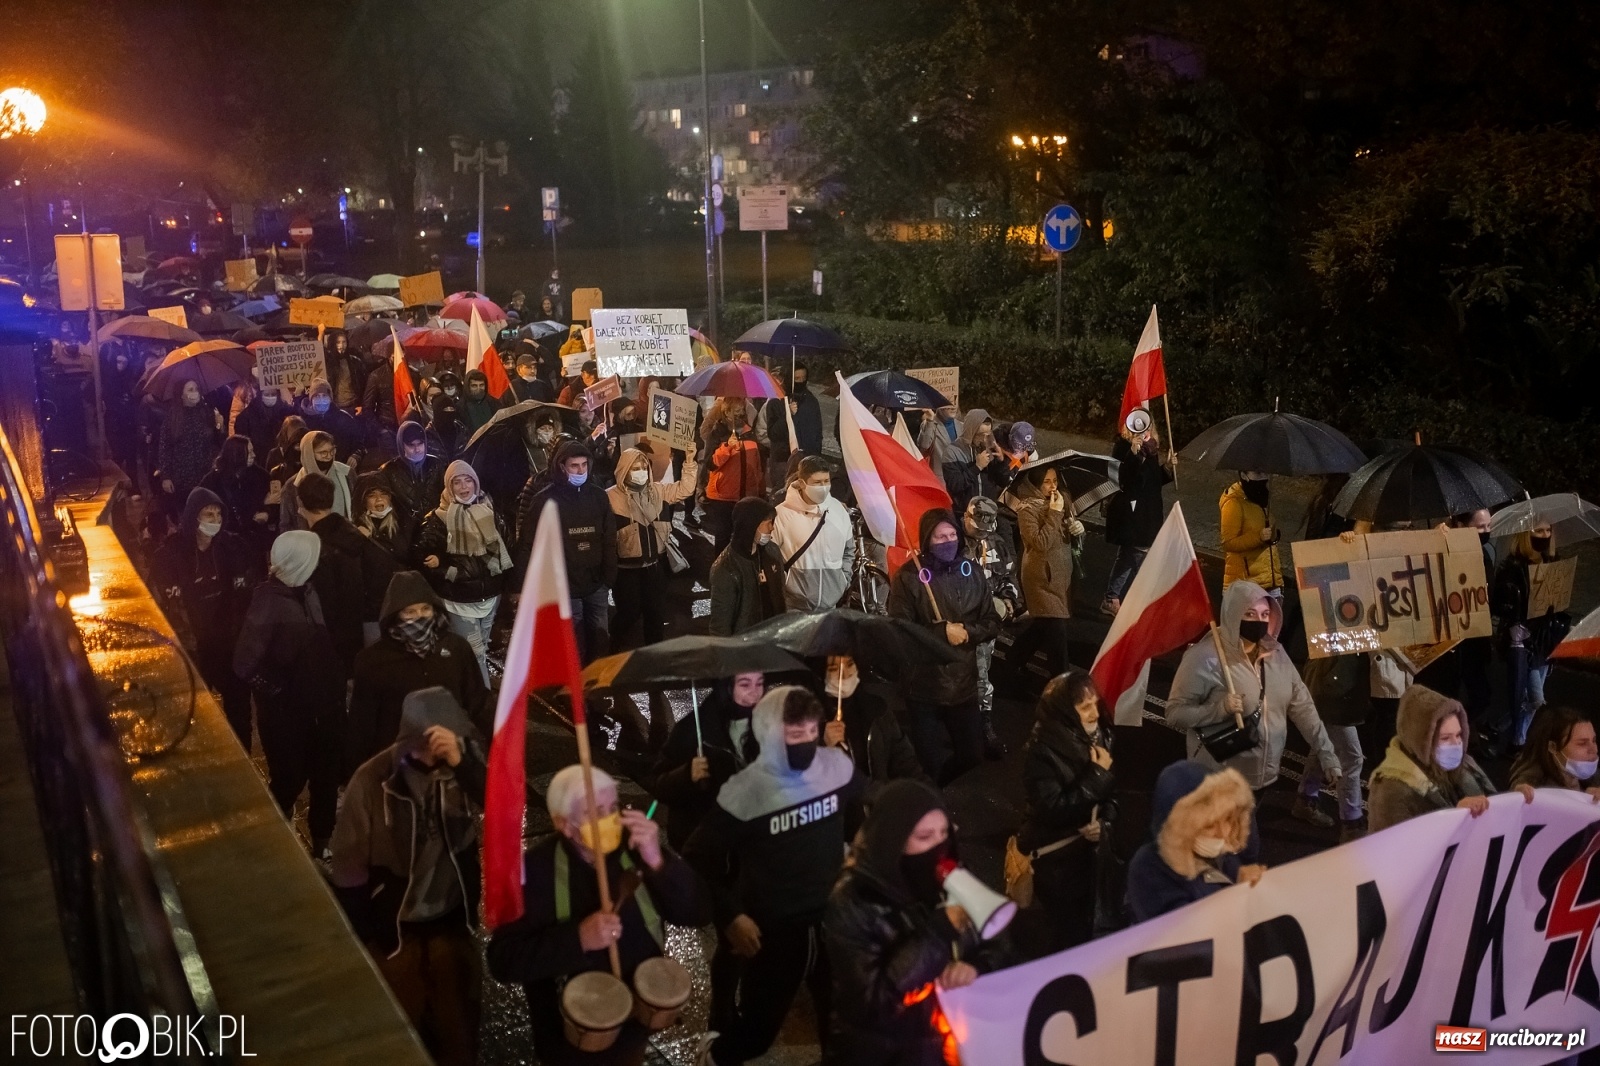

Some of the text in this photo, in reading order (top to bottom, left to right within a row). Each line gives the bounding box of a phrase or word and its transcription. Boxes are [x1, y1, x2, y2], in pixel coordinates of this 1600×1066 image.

[546, 190, 556, 207] P
[616, 313, 663, 325] BEZ KOBIET
[257, 346, 285, 358] JAREK
[620, 339, 669, 351] BEZ KOBIET
[260, 353, 316, 366] CHORE DZIECKO
[264, 374, 284, 386] NIE
[674, 421, 696, 440] FUN
[1296, 553, 1489, 655] To jest Wojna
[769, 794, 839, 835] OUTSIDER
[1022, 825, 1546, 1066] STRAJK
